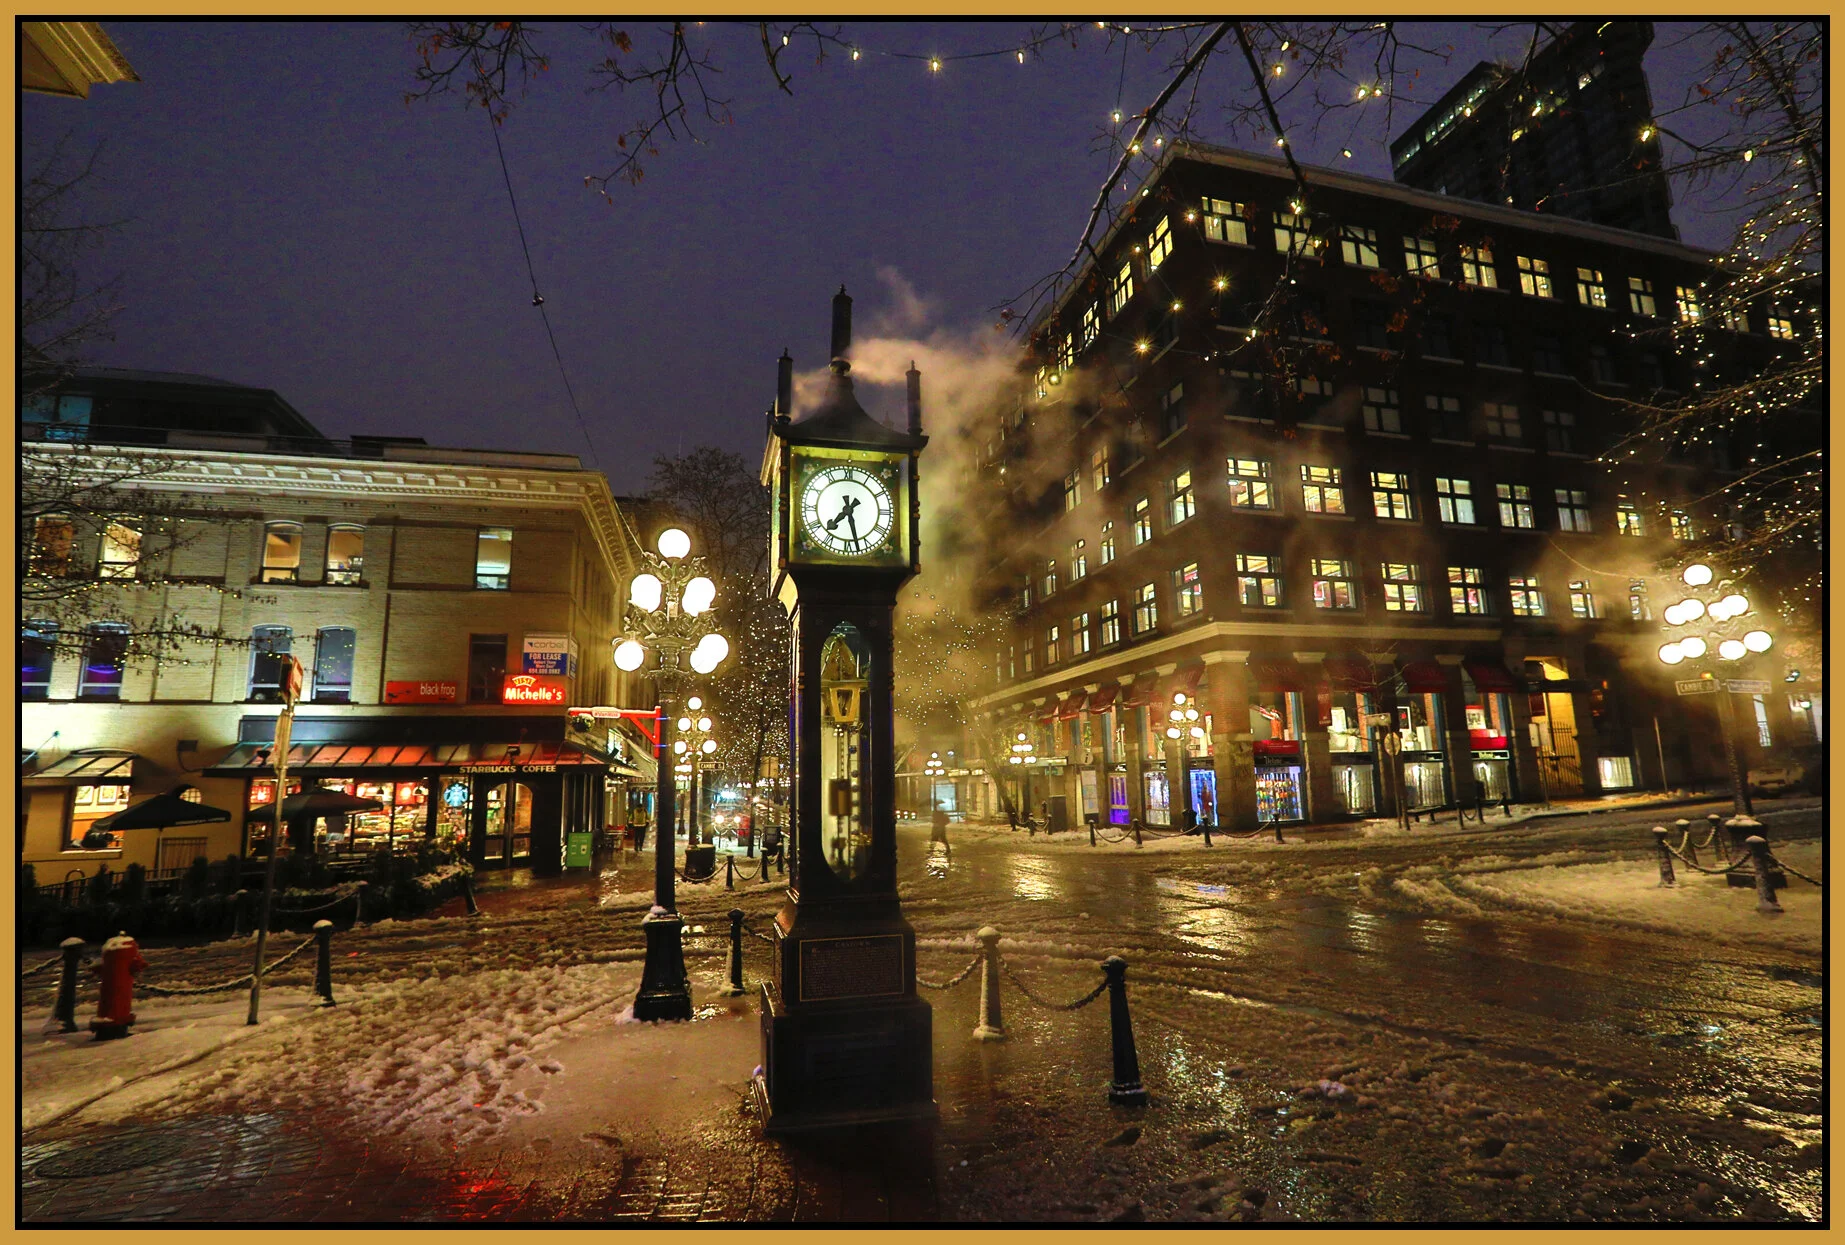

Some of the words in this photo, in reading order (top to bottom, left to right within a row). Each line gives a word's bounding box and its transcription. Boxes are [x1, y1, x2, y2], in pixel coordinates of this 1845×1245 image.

[420, 683, 439, 696] black
[440, 683, 456, 699] frog
[505, 687, 562, 701] Michelle's
